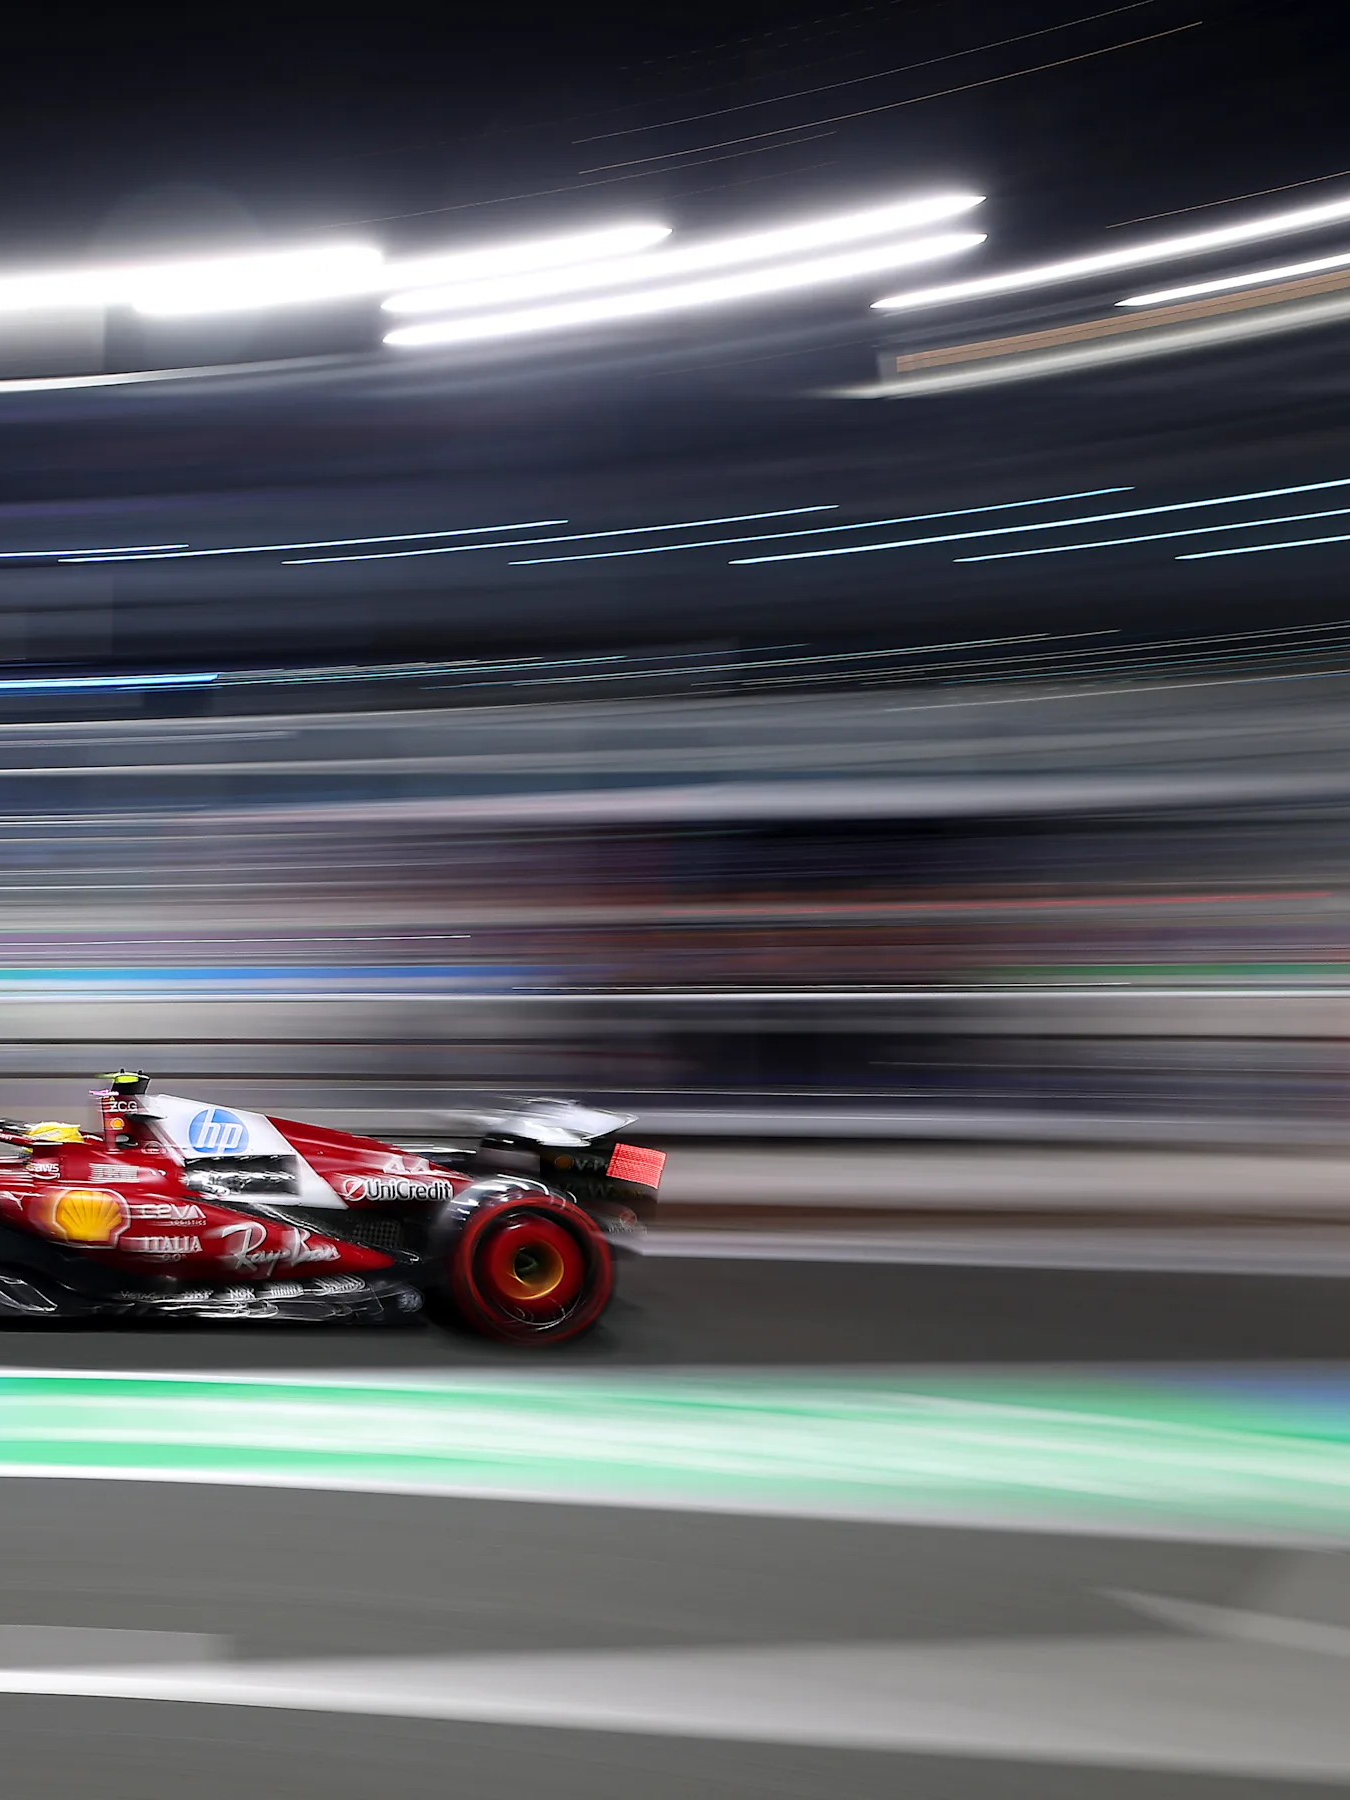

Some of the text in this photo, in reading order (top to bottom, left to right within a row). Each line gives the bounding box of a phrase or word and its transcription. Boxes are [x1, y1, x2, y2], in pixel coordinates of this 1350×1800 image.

[196, 1109, 244, 1154] hp
[34, 1163, 60, 1173] aws
[367, 1179, 454, 1201] UniCredit
[144, 1236, 203, 1252] ITALIA
